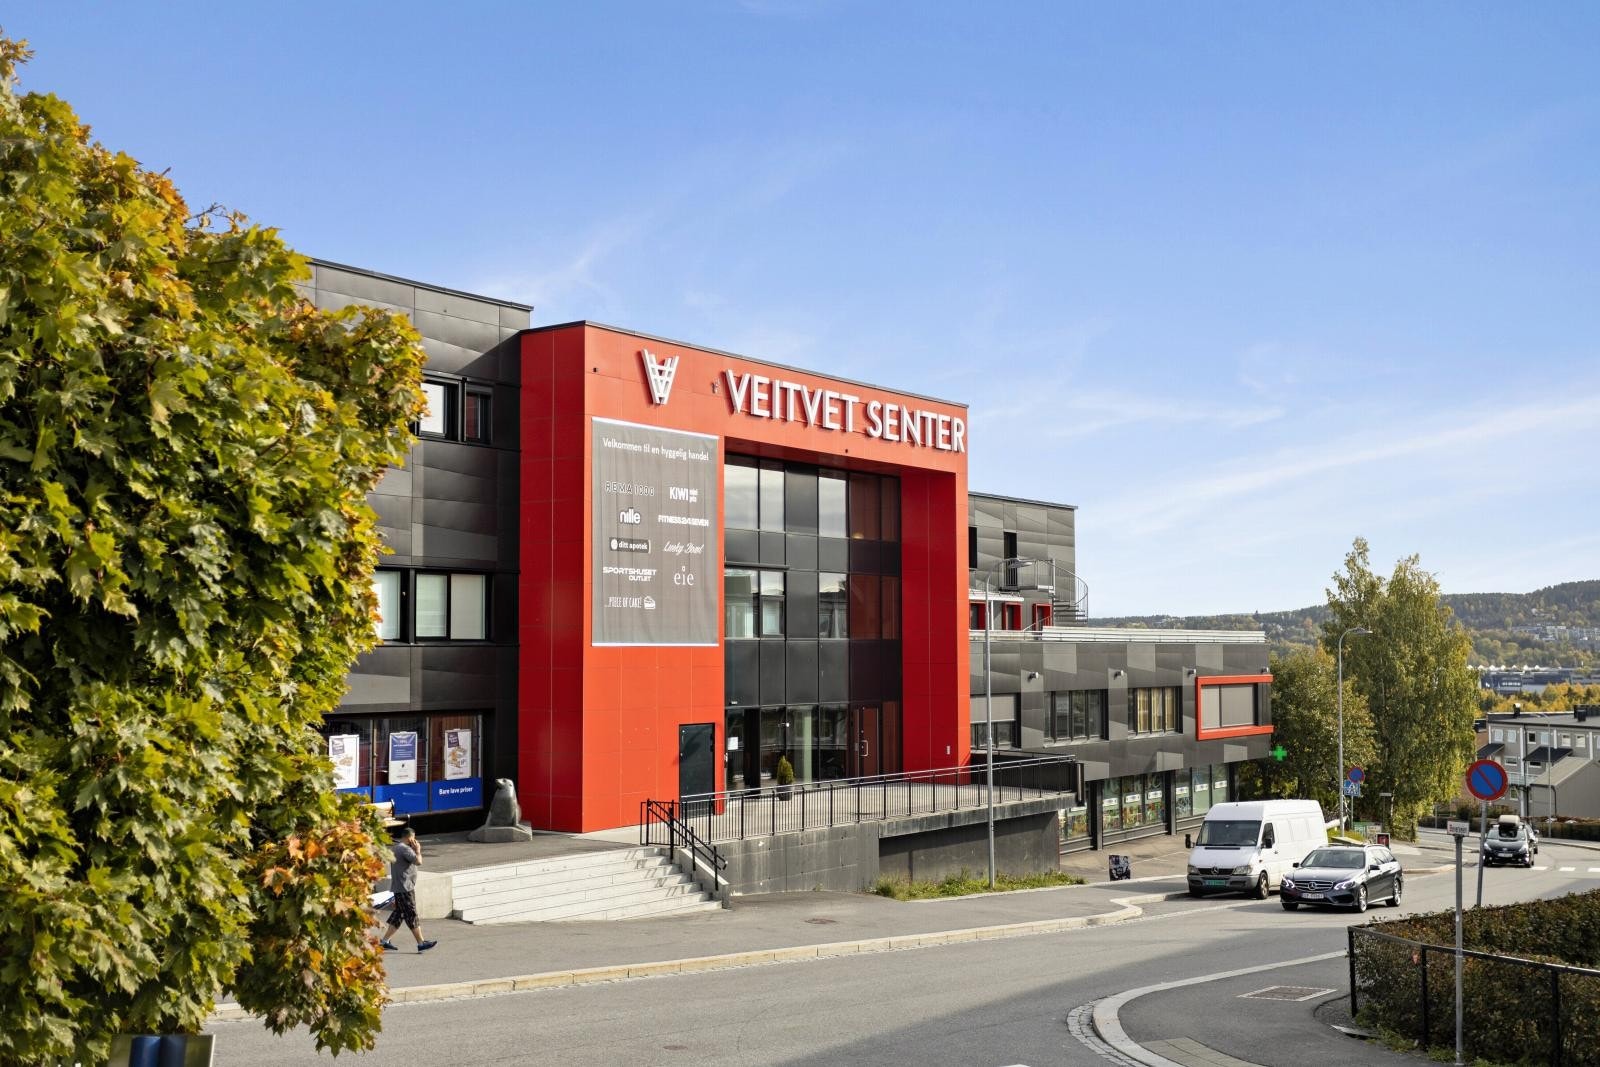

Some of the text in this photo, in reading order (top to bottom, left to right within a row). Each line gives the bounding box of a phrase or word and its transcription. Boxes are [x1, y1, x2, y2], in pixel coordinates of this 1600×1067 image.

[725, 368, 965, 453] VEITVET SENTER
[602, 438, 642, 452] Velkommen
[651, 447, 660, 455] en
[661, 446, 687, 461] hyggelig
[688, 449, 709, 461] handel
[605, 480, 632, 495] REMA
[669, 486, 689, 501] KIWI
[620, 508, 641, 524] nille
[602, 566, 657, 576] SPORTSHUSET
[673, 565, 695, 586] eie
[450, 787, 460, 795] lave
[460, 786, 473, 795] priser
